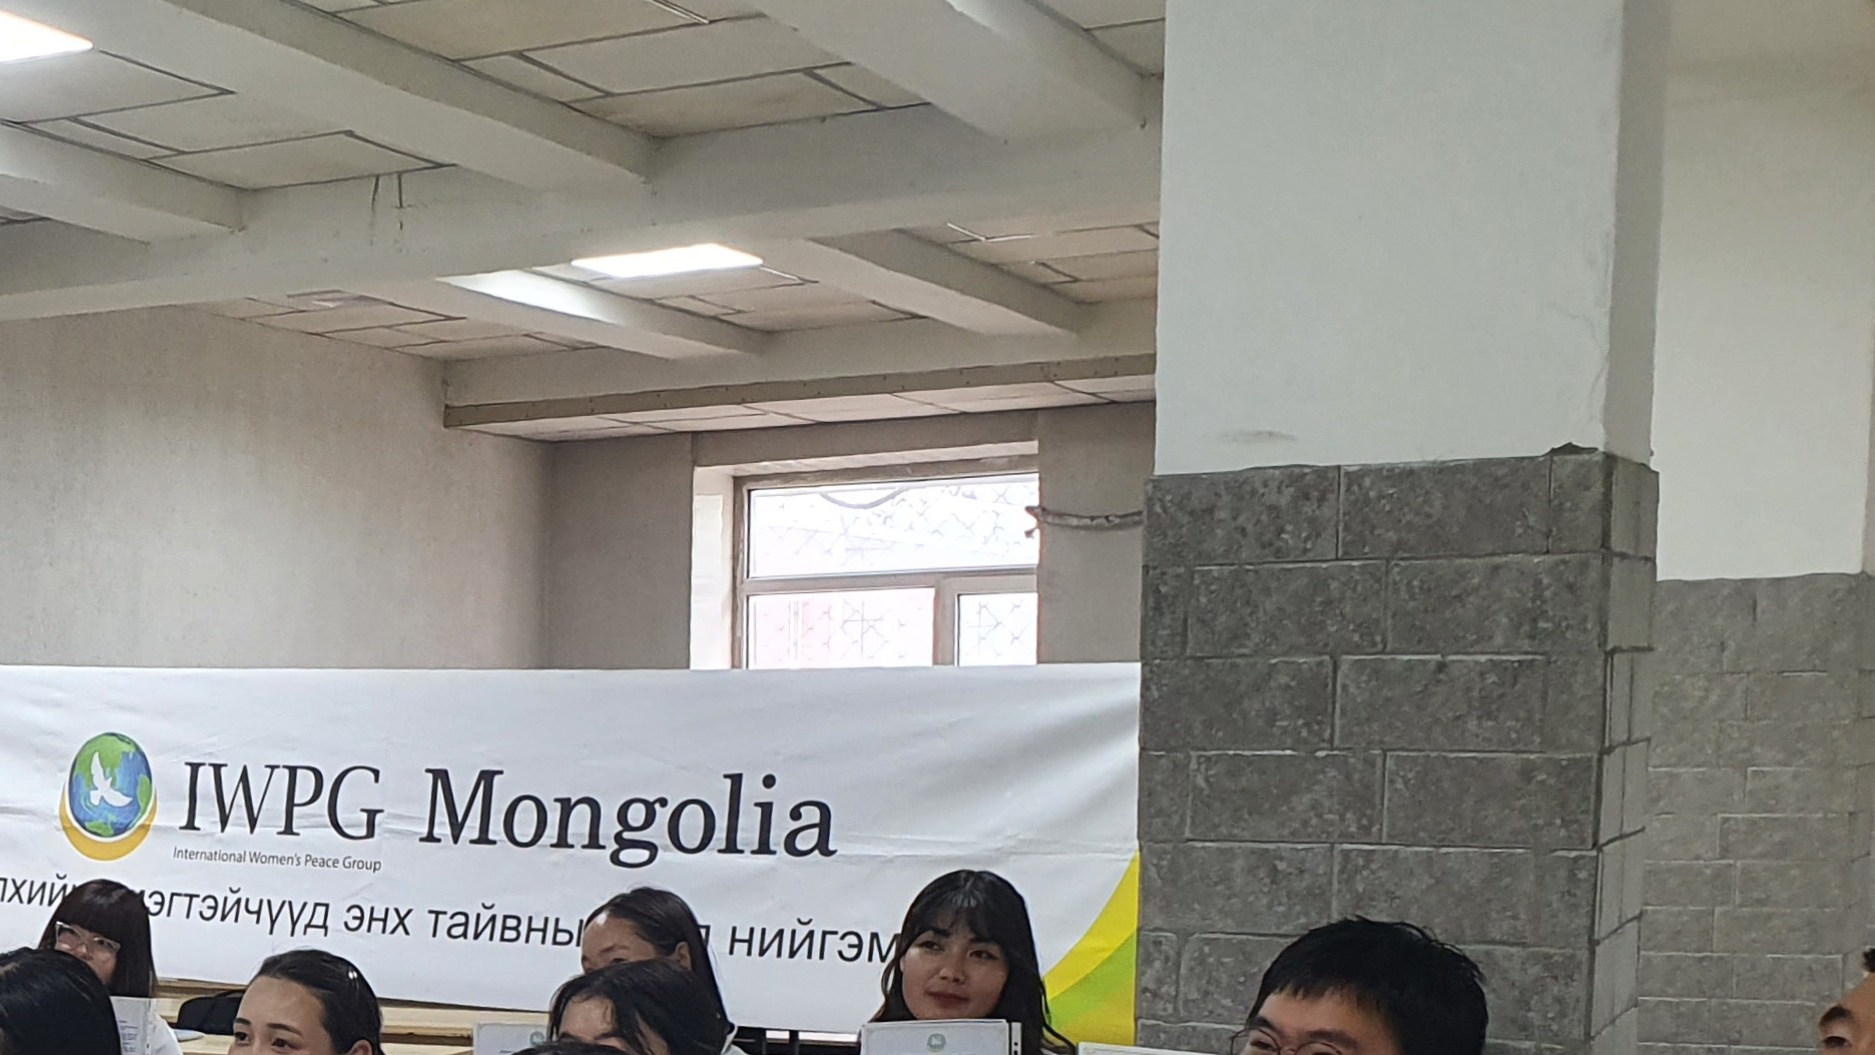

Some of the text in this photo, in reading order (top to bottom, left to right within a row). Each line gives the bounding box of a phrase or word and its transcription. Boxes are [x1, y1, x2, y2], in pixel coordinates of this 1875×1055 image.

[178, 761, 838, 868] IWPG Mongolia
[173, 846, 382, 874] International Women's Peace Group
[136, 887, 331, 937] эгтэйчүүд
[344, 902, 413, 937] энх
[426, 902, 582, 948] тайвны
[728, 918, 902, 963] нийгэм
